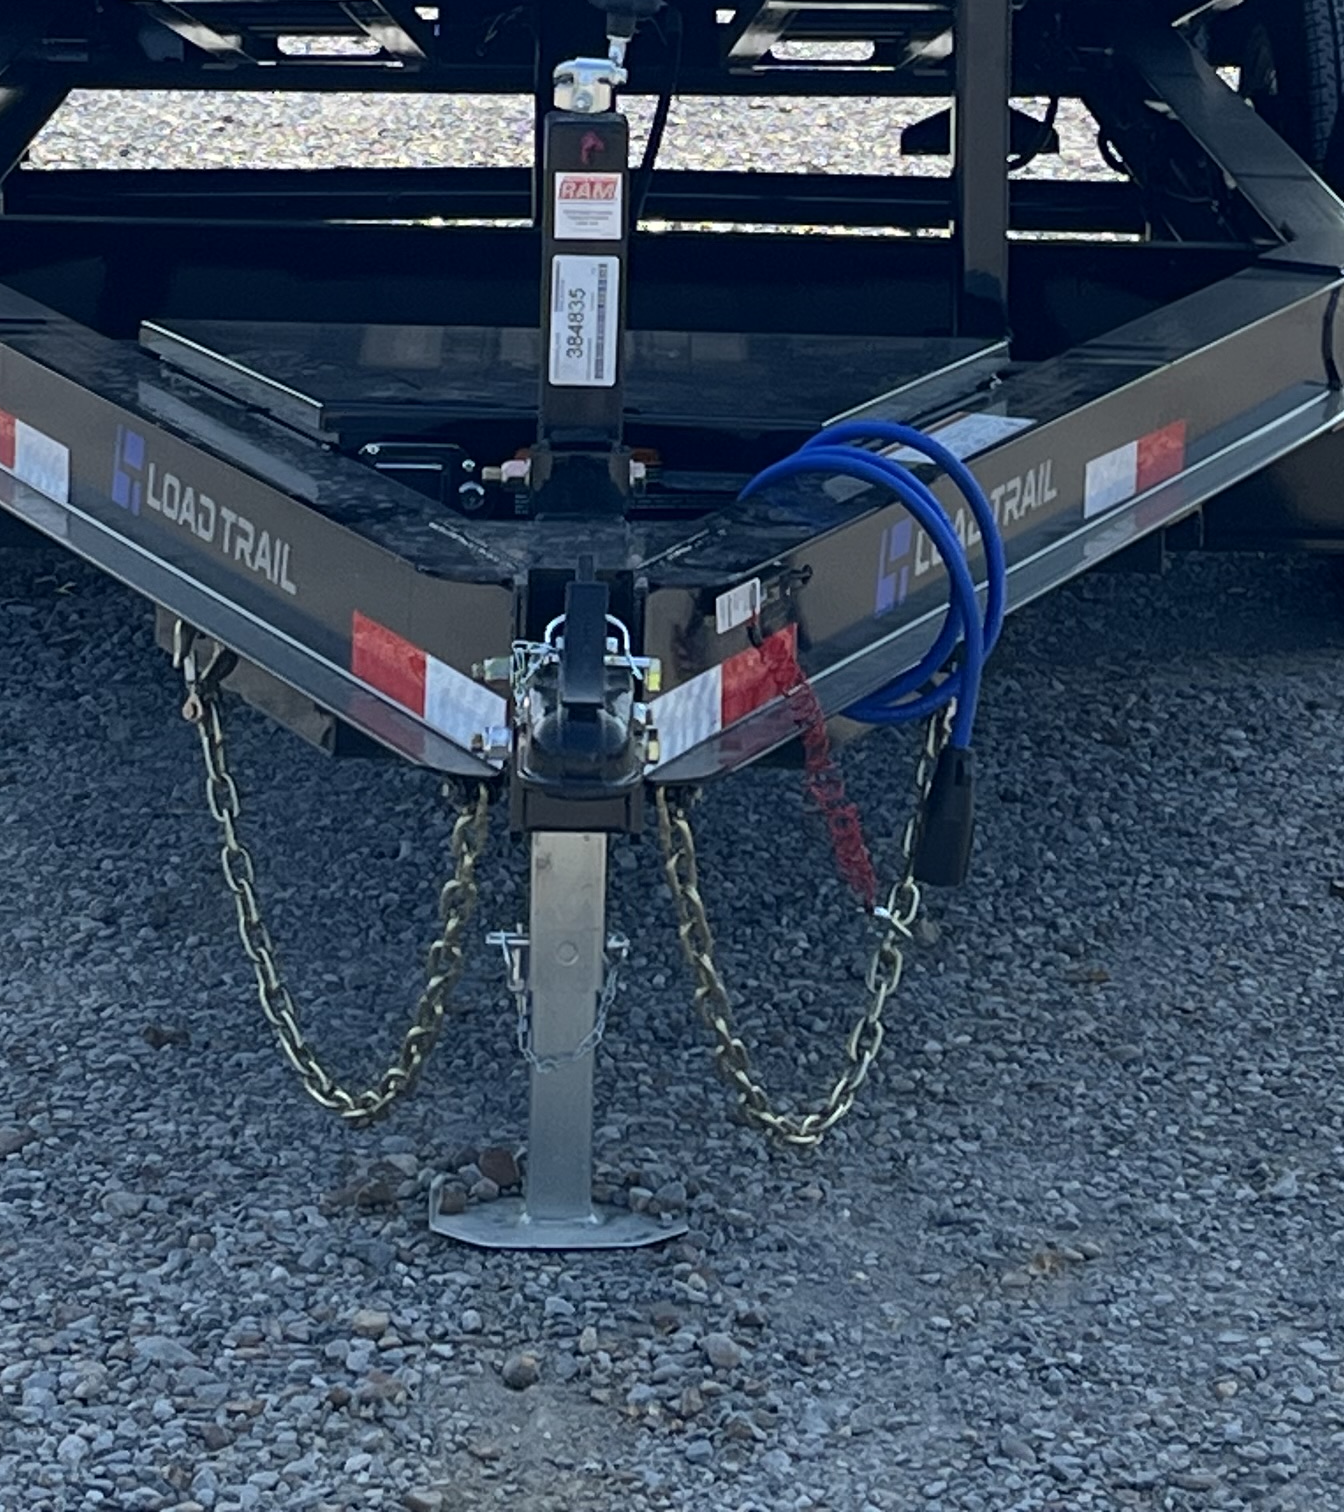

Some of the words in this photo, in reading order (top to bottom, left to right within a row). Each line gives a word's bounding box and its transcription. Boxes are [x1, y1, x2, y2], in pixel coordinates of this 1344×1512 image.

[560, 181, 617, 200] RAM
[565, 287, 587, 359] 384835
[990, 458, 1057, 527] TRAIL
[146, 462, 217, 543] LOAD
[219, 505, 298, 596] TRAIL
